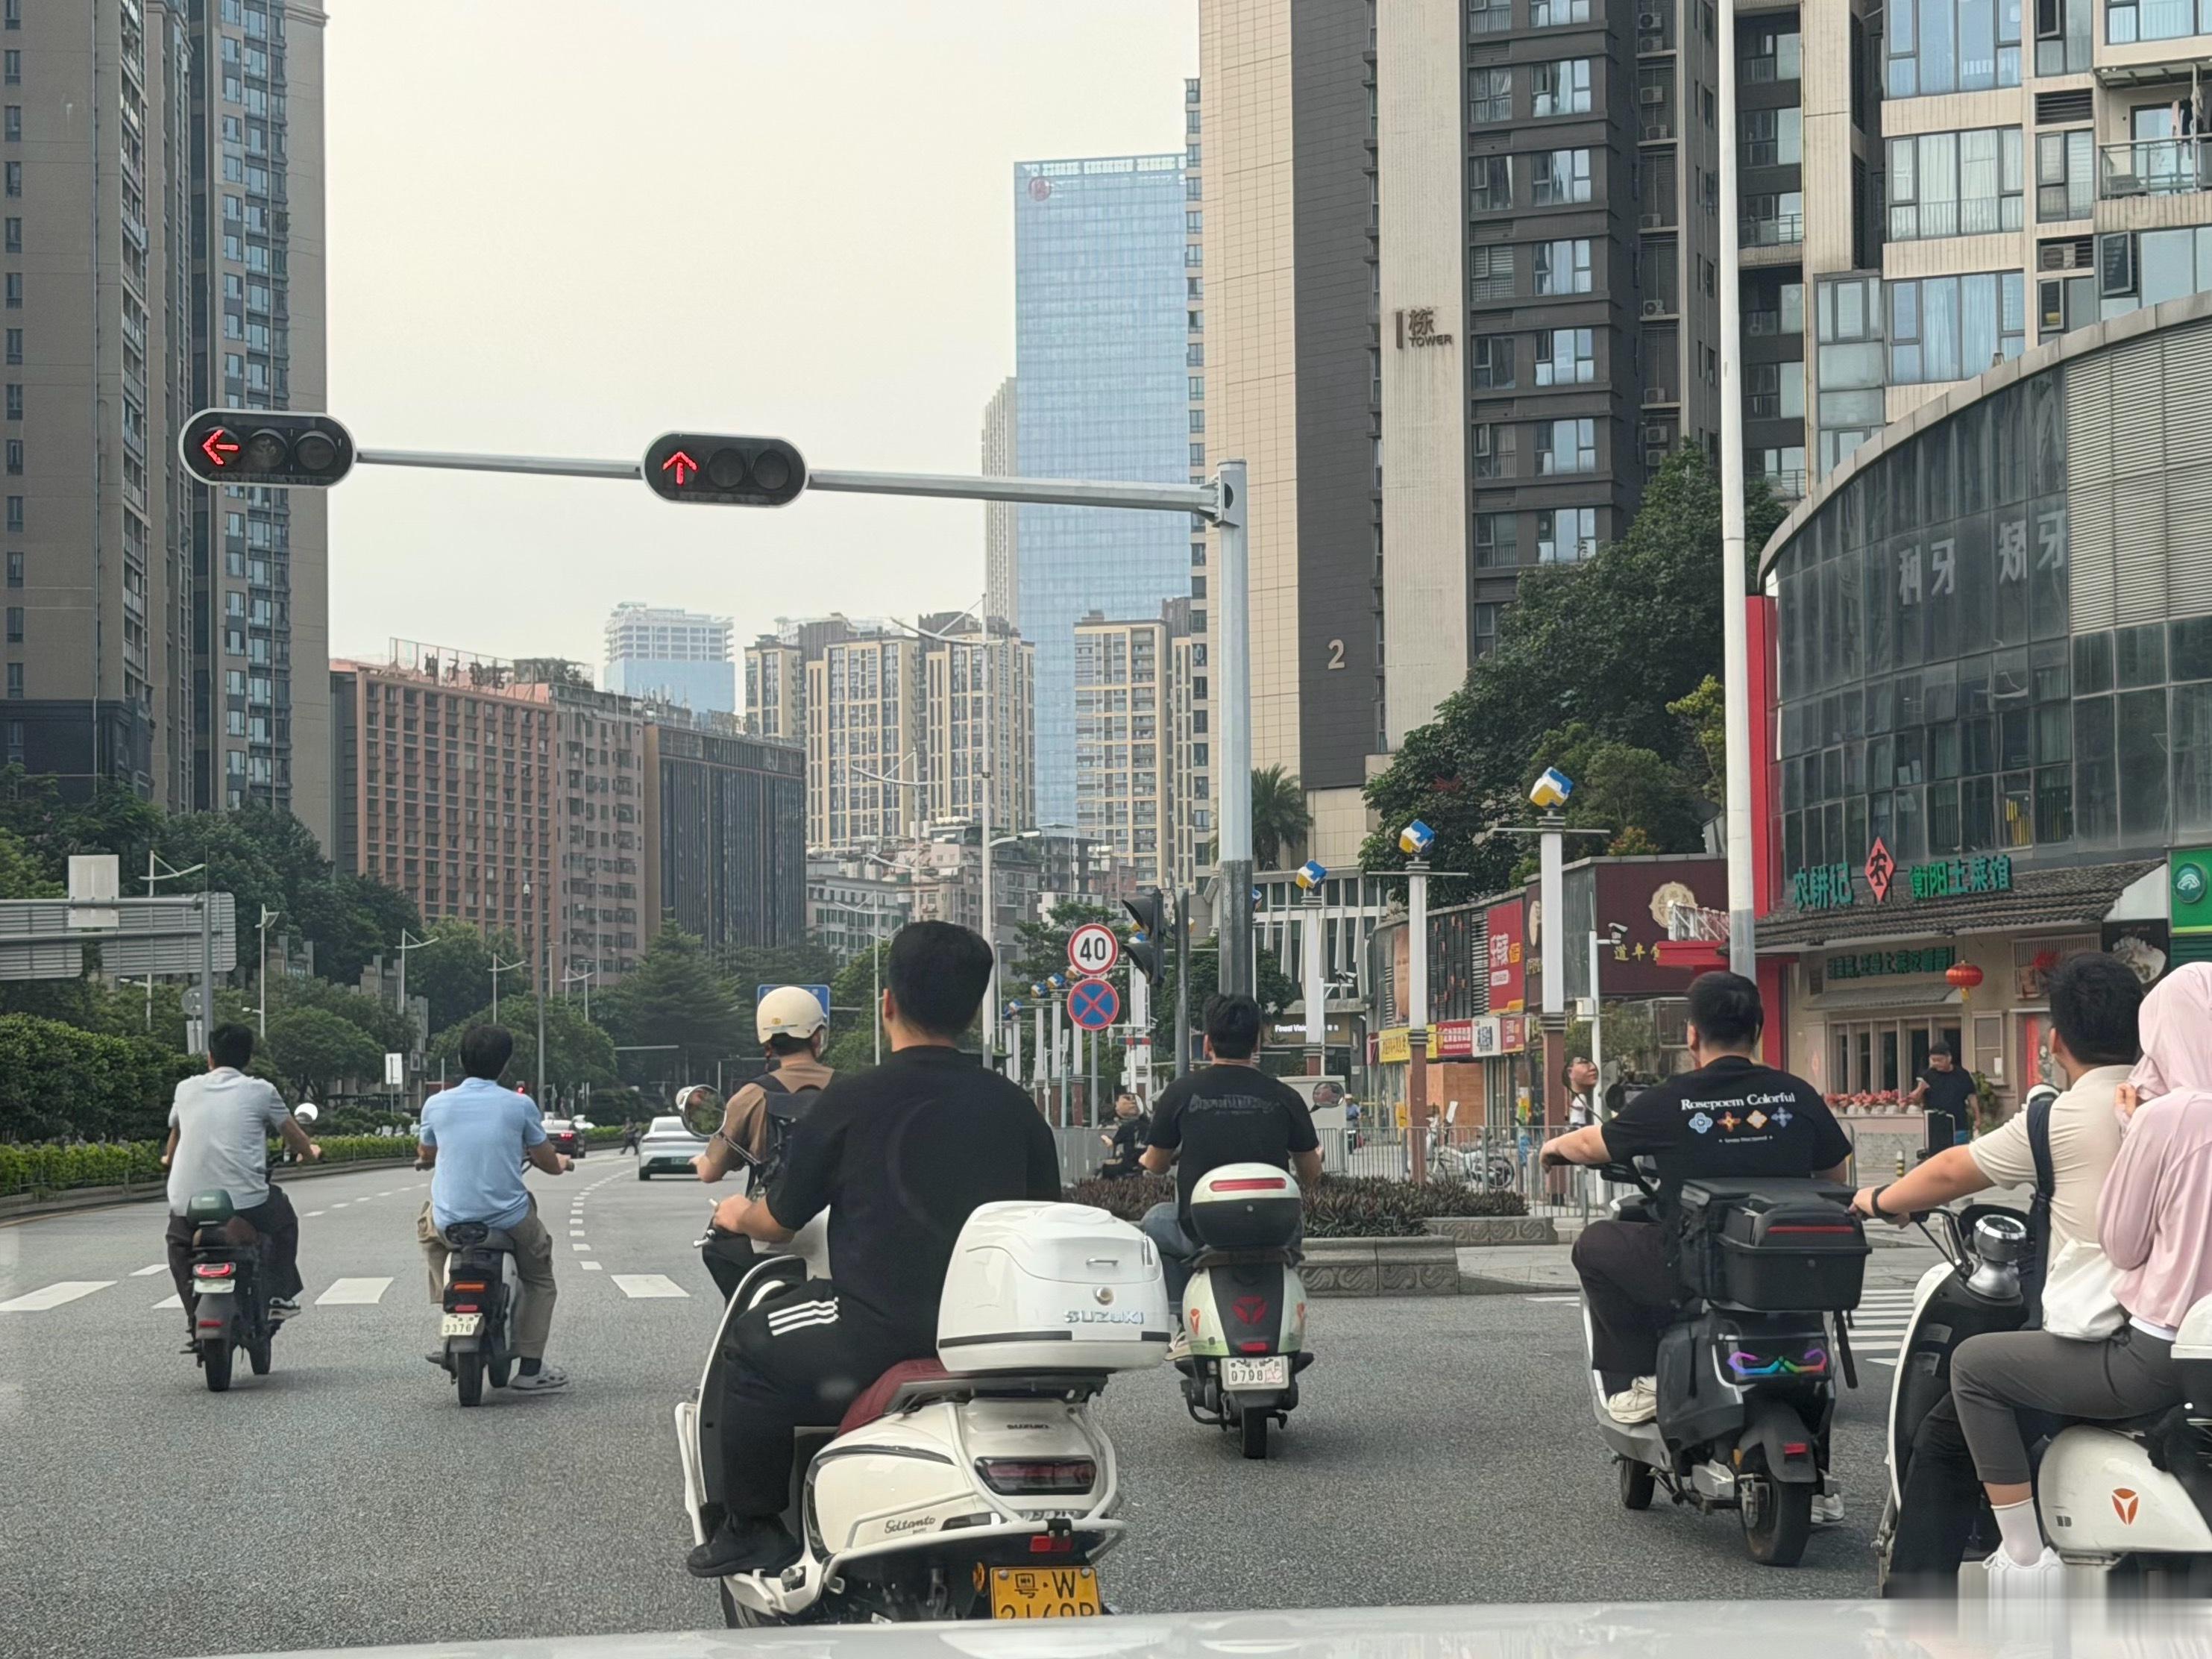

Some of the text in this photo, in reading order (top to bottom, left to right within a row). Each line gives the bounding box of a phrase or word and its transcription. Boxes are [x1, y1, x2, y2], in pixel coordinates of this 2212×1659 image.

[1409, 334, 1452, 348] TOWER
[1328, 639, 1345, 669] 2
[1910, 854, 2013, 900] 衡阳土菜馆
[1080, 937, 1106, 962] 40
[1747, 1092, 1796, 1106] Colorful
[1064, 1311, 1144, 1325] SUZUKI
